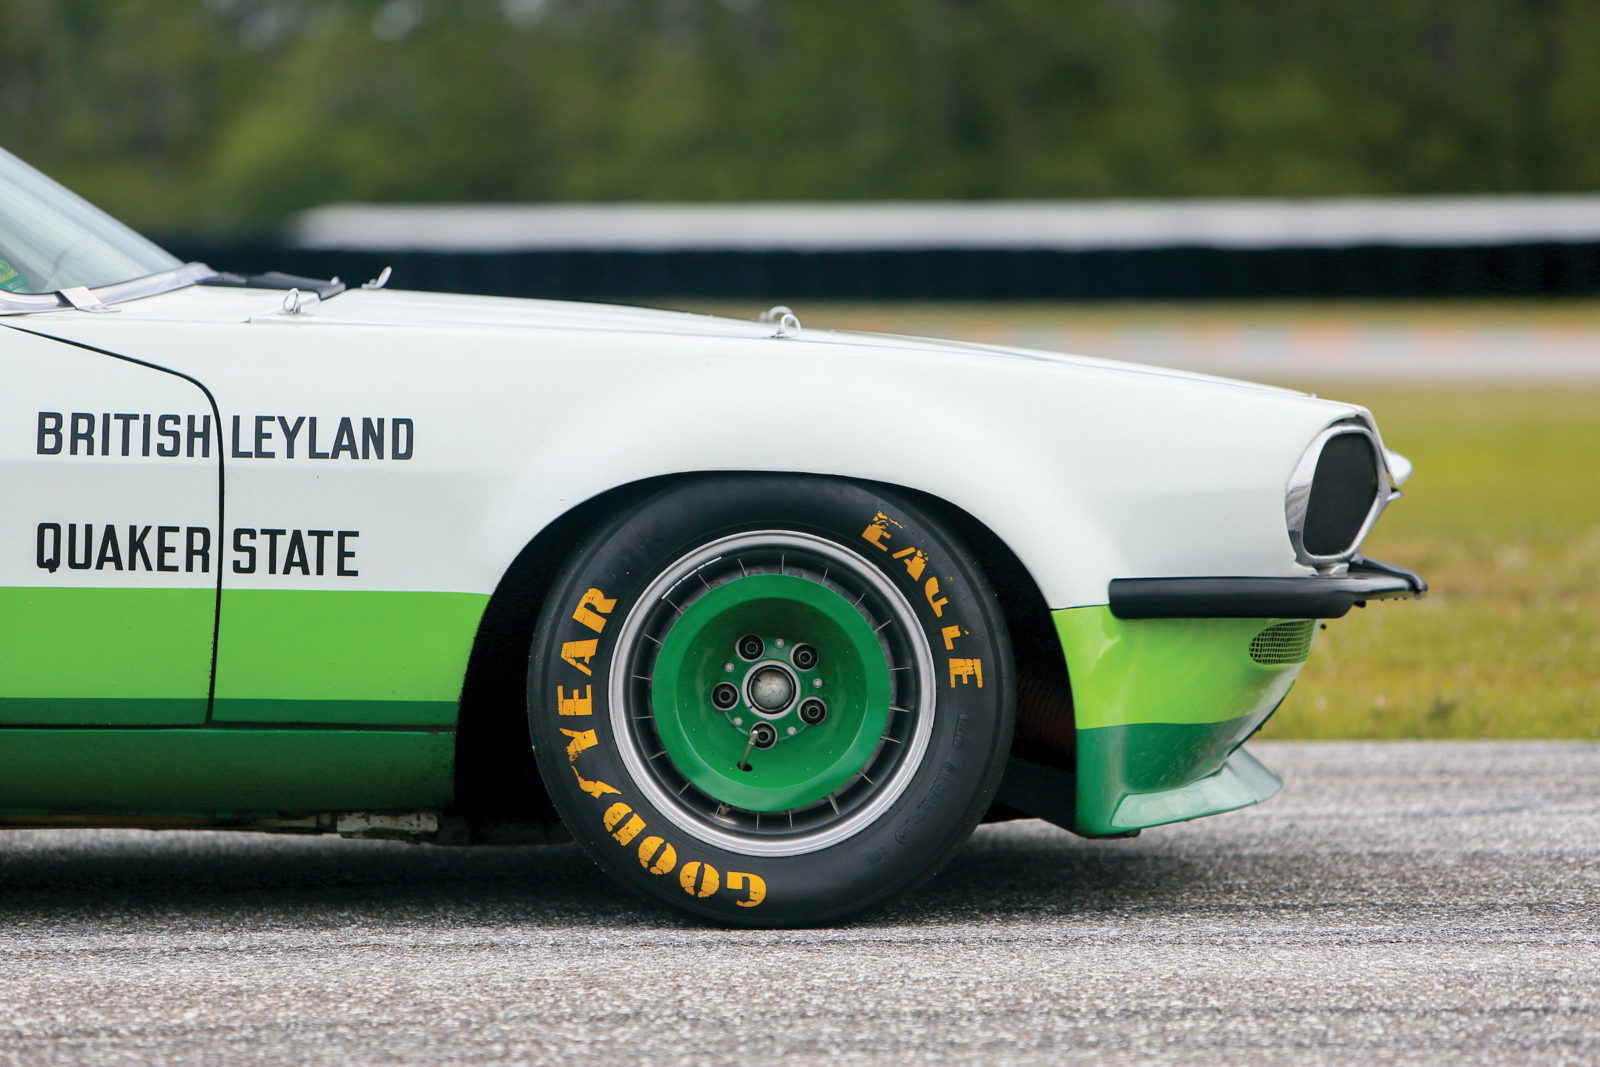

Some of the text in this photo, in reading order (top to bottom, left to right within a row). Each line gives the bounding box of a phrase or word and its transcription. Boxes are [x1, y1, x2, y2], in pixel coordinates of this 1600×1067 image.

[37, 411, 414, 460] BRITISH LEYLAND
[36, 522, 360, 576] QUAKER STATE
